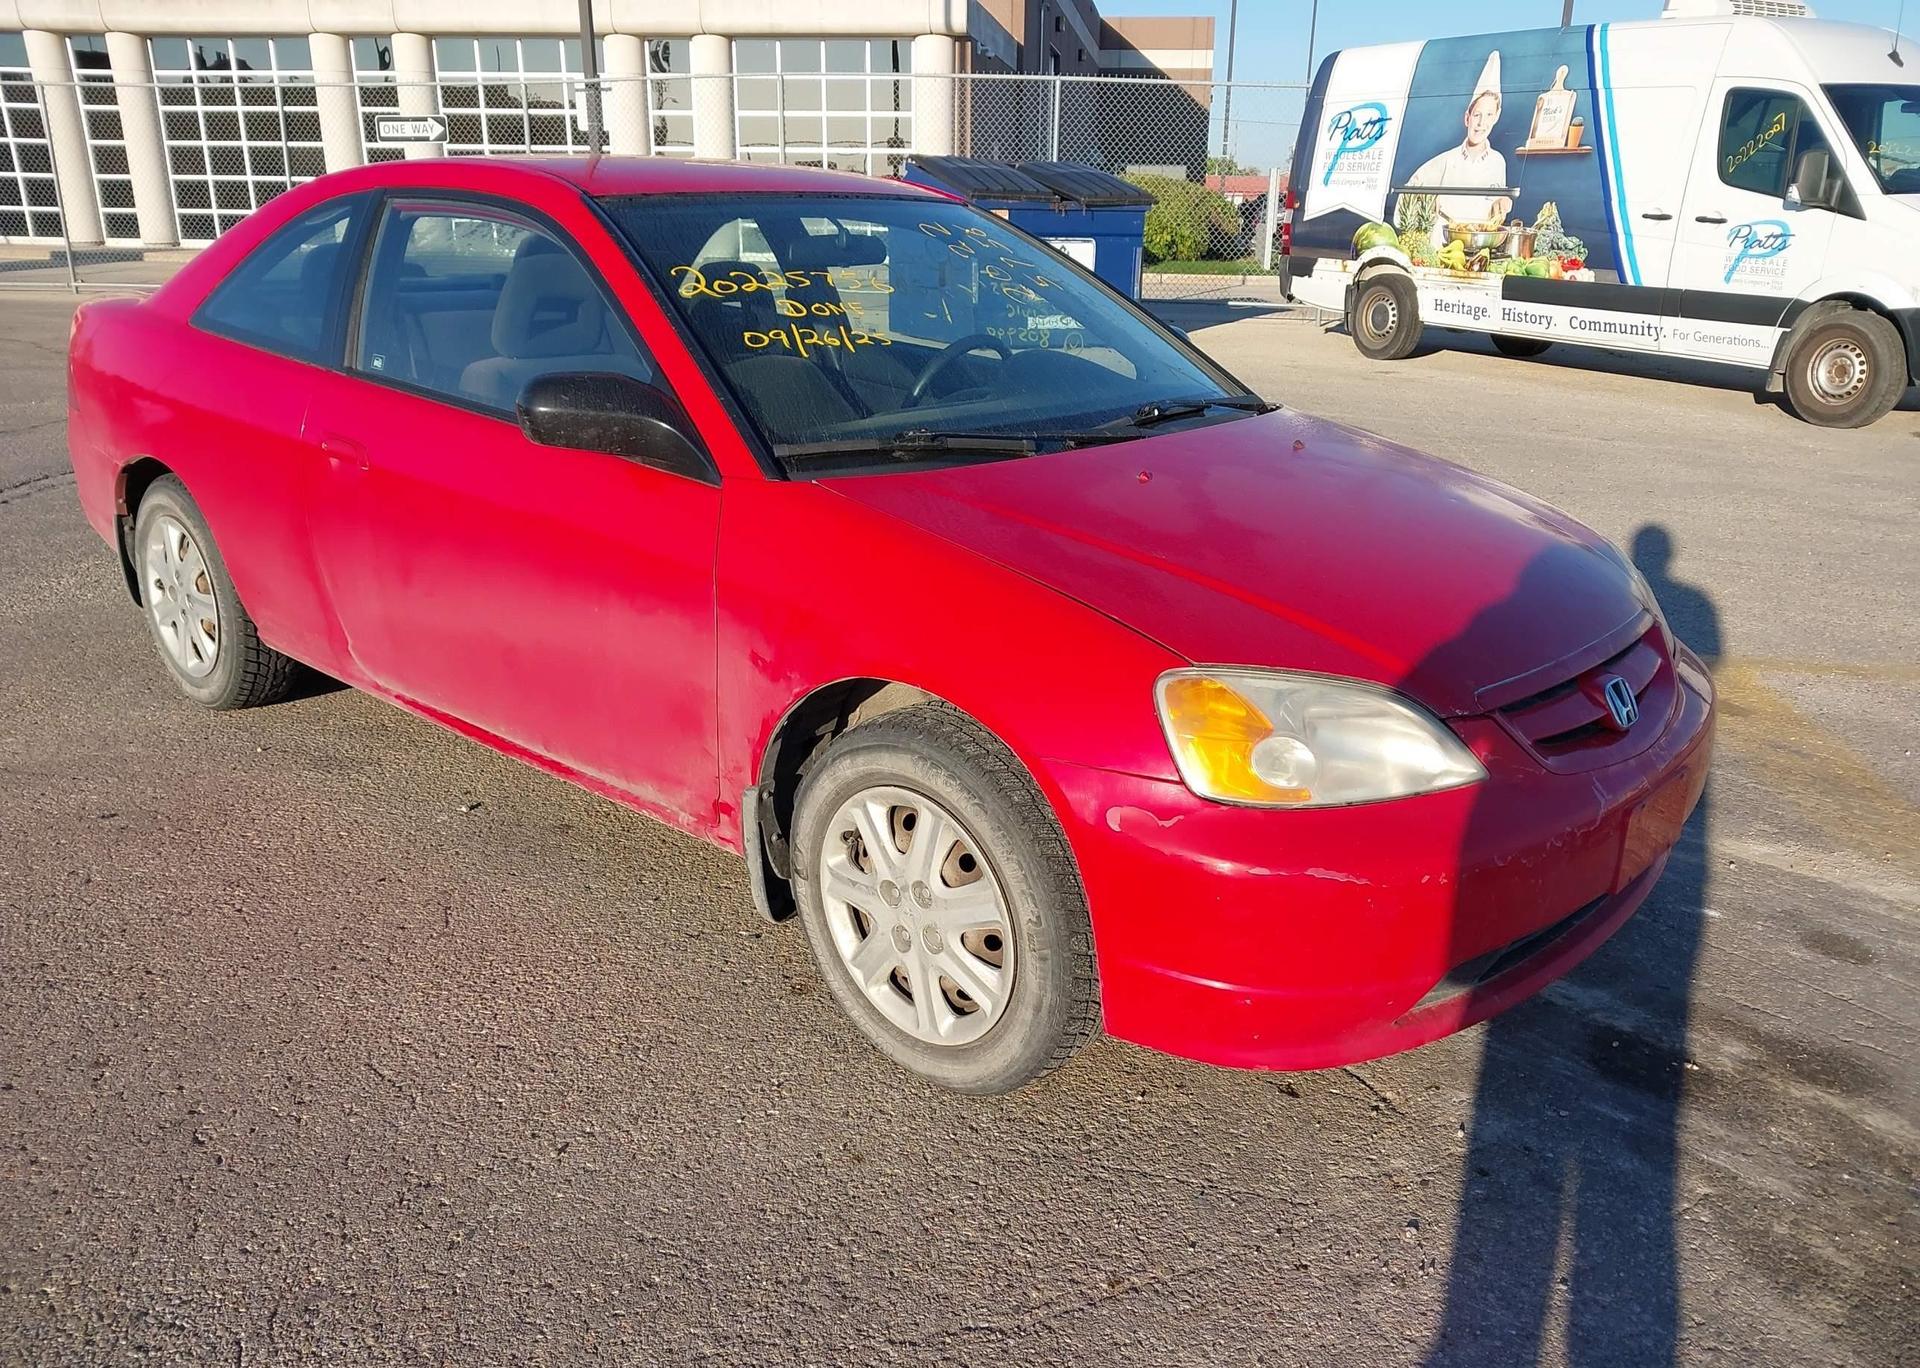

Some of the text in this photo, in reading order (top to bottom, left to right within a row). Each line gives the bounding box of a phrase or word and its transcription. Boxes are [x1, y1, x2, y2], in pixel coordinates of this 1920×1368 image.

[383, 123, 435, 134] ONE WAY
[1328, 110, 1393, 142] Pratts
[1325, 150, 1384, 161] WHOLESALE
[1323, 161, 1382, 172] FOOD SERVICE
[1727, 224, 1796, 251] Pratts
[1723, 255, 1788, 267] WHOLESALE
[1724, 264, 1786, 276] FOOD SERVICE
[776, 300, 865, 317] DONE
[1434, 298, 1770, 349] Heritage. History. Community. For Generations...
[743, 322, 892, 358] 09/26/25
